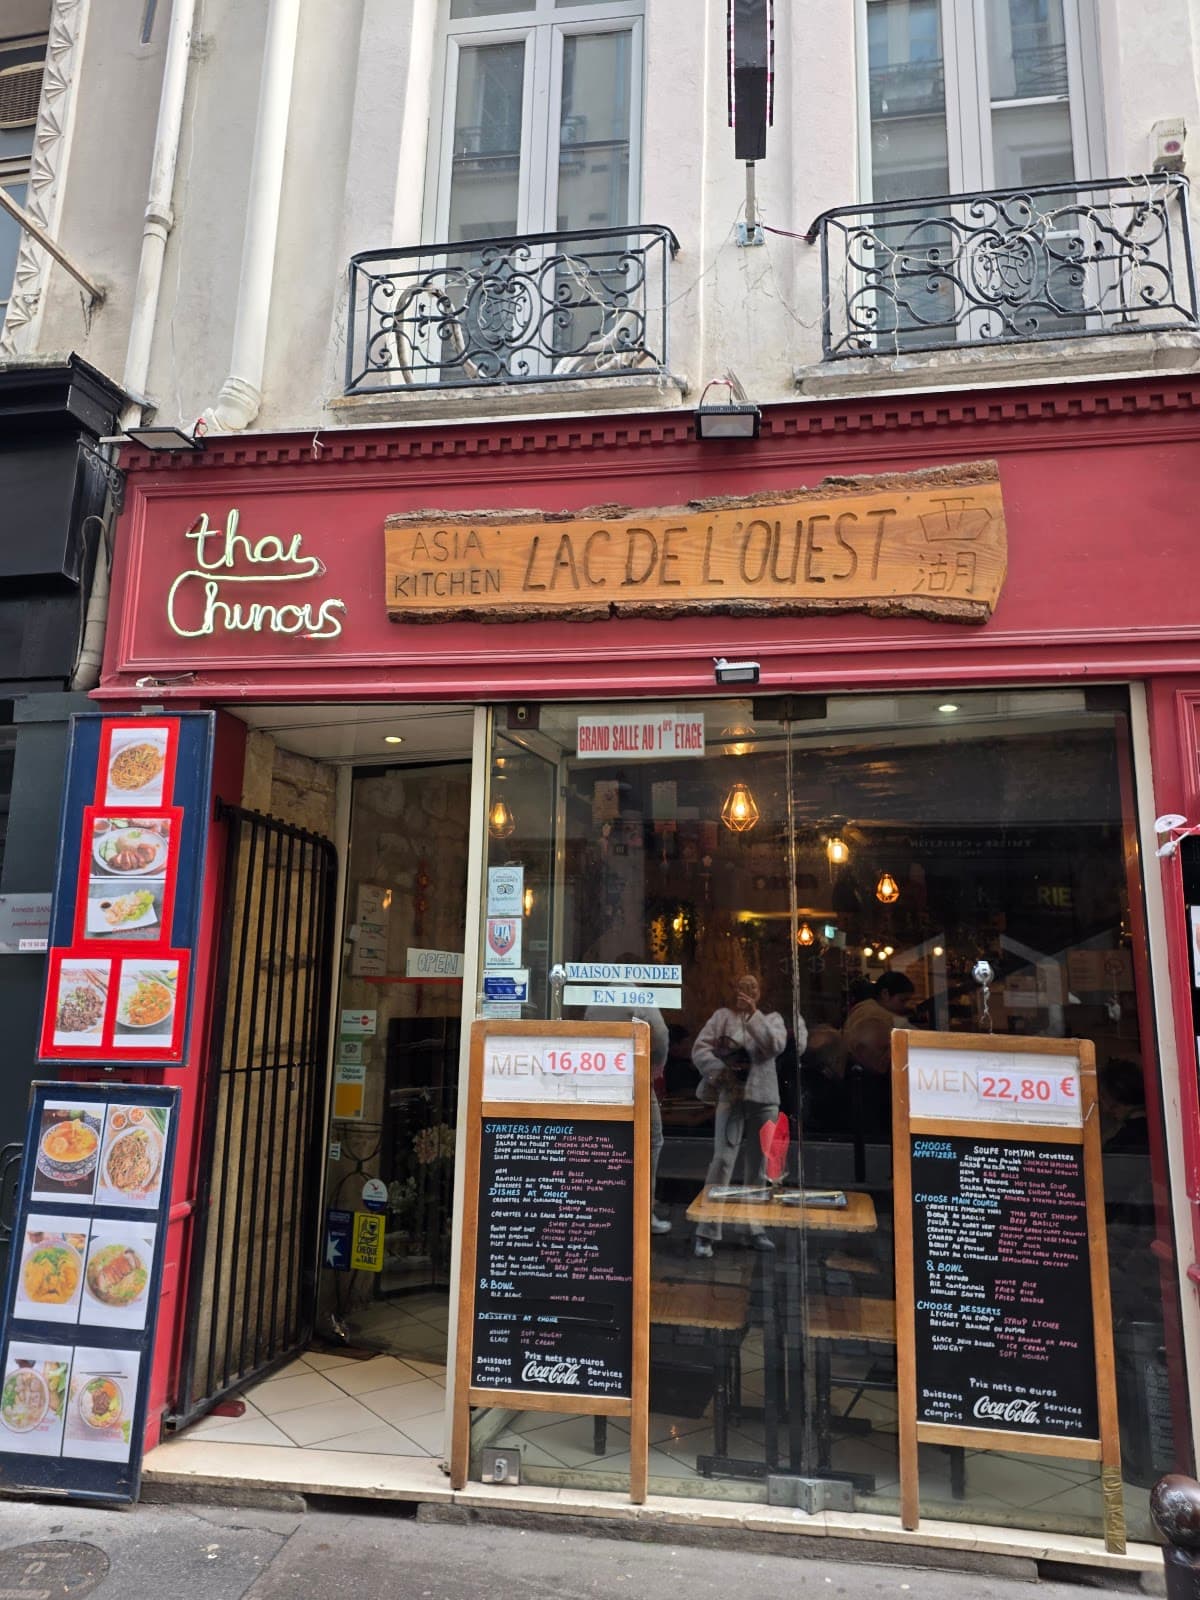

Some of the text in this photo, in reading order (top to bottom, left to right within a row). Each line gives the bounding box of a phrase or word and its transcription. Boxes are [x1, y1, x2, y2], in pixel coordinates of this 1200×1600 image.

[412, 531, 485, 562] ASIA
[522, 509, 897, 592] LAC DE L'OUEST
[394, 570, 500, 598] KITCHEN
[580, 725, 609, 751] GRAND
[613, 725, 639, 751] SALLE
[642, 724, 654, 750] AU
[675, 723, 702, 749] ETAGE
[417, 953, 459, 974] OPEN
[569, 966, 679, 981] MAISON FONDEE
[592, 990, 654, 1004] EN 1962
[492, 1055, 548, 1076] MEN
[548, 1052, 627, 1074] 16,80 €
[917, 1069, 979, 1093] MEN
[982, 1077, 1075, 1103] 22,80 €
[485, 1124, 574, 1135] STARTERS AT CHOICE
[914, 1141, 952, 1151] CHOOSE
[974, 1145, 999, 1155] SOUPE
[488, 1188, 520, 1196] DISHES
[914, 1193, 998, 1207] CHOOSE MAIN COURSE
[926, 1260, 964, 1272] & BOWL
[480, 1278, 515, 1289] & BOWL
[917, 1300, 1001, 1316] CHOOSE DESSERTS
[933, 1344, 964, 1352] NOUGAT
[1000, 1350, 1018, 1358] SOFT
[476, 1356, 511, 1365] Boissons
[524, 1351, 541, 1360] Prix
[545, 1354, 563, 1362] nets
[580, 1358, 604, 1366] euros
[476, 1374, 512, 1385] Compris
[588, 1368, 623, 1378] Services
[588, 1379, 622, 1391] Compris
[969, 1377, 1057, 1397] Prix nets en euros
[922, 1389, 962, 1401] Boissons
[924, 1408, 962, 1421] compris
[1043, 1402, 1082, 1414] Services
[1045, 1416, 1083, 1429] Compris
